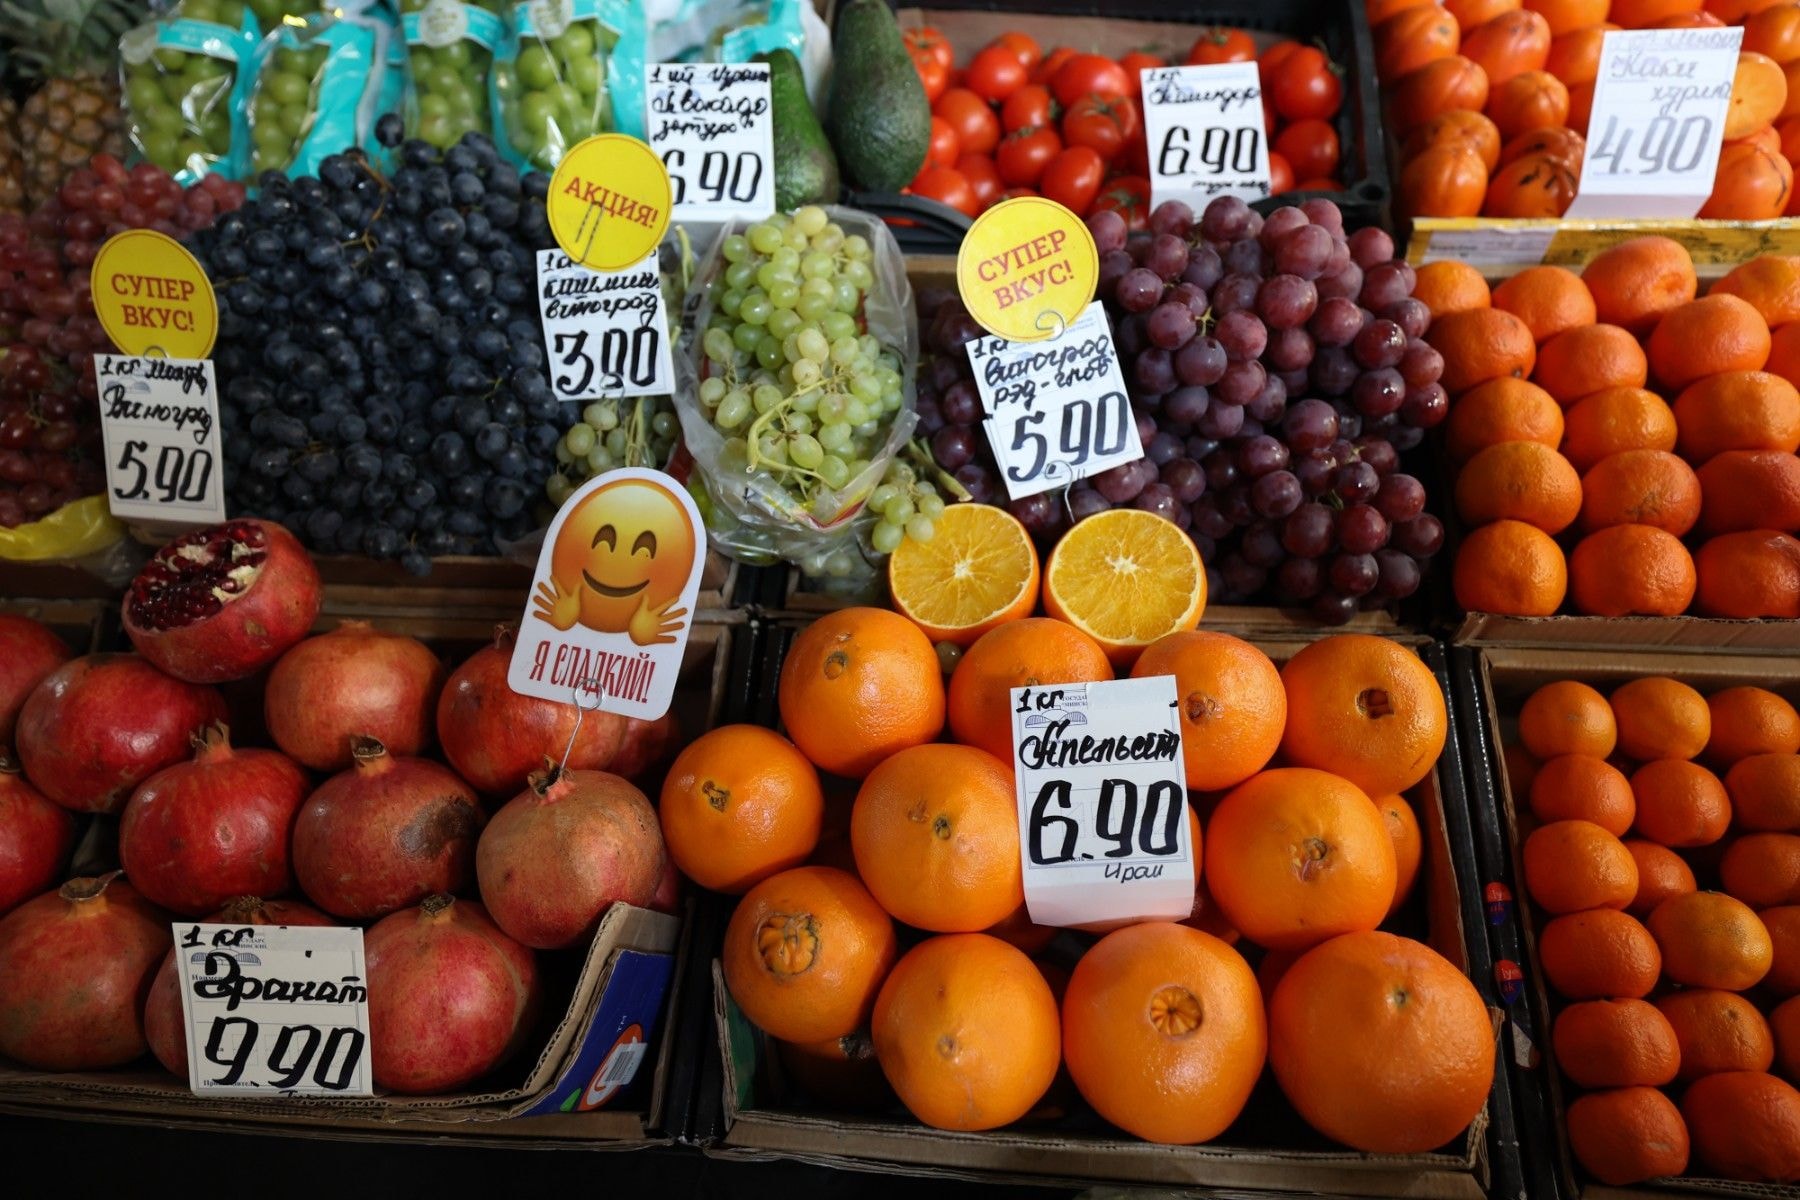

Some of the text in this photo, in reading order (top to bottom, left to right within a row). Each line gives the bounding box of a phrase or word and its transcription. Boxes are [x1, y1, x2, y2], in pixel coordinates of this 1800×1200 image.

[650, 66, 662, 83] 1
[1158, 126, 1258, 176] 6.90
[1591, 115, 1712, 175] 4.90
[564, 176, 658, 229] АКЦИЯ!
[978, 229, 1066, 281] СУПЕР
[111, 273, 195, 301] СУПЕР
[993, 259, 1074, 309] ВКУС!
[121, 304, 195, 332] ВКУС!
[101, 356, 112, 375] 1
[116, 359, 140, 375] кг
[1007, 391, 1128, 482] 5.90
[114, 440, 212, 503] 5.90
[529, 640, 656, 704] Я СЛАДКИЙ!
[1016, 689, 1064, 712] 1 кг
[1029, 779, 1183, 865] 6.90
[181, 925, 254, 948] 1 кг
[205, 1016, 365, 1090] 9.90
